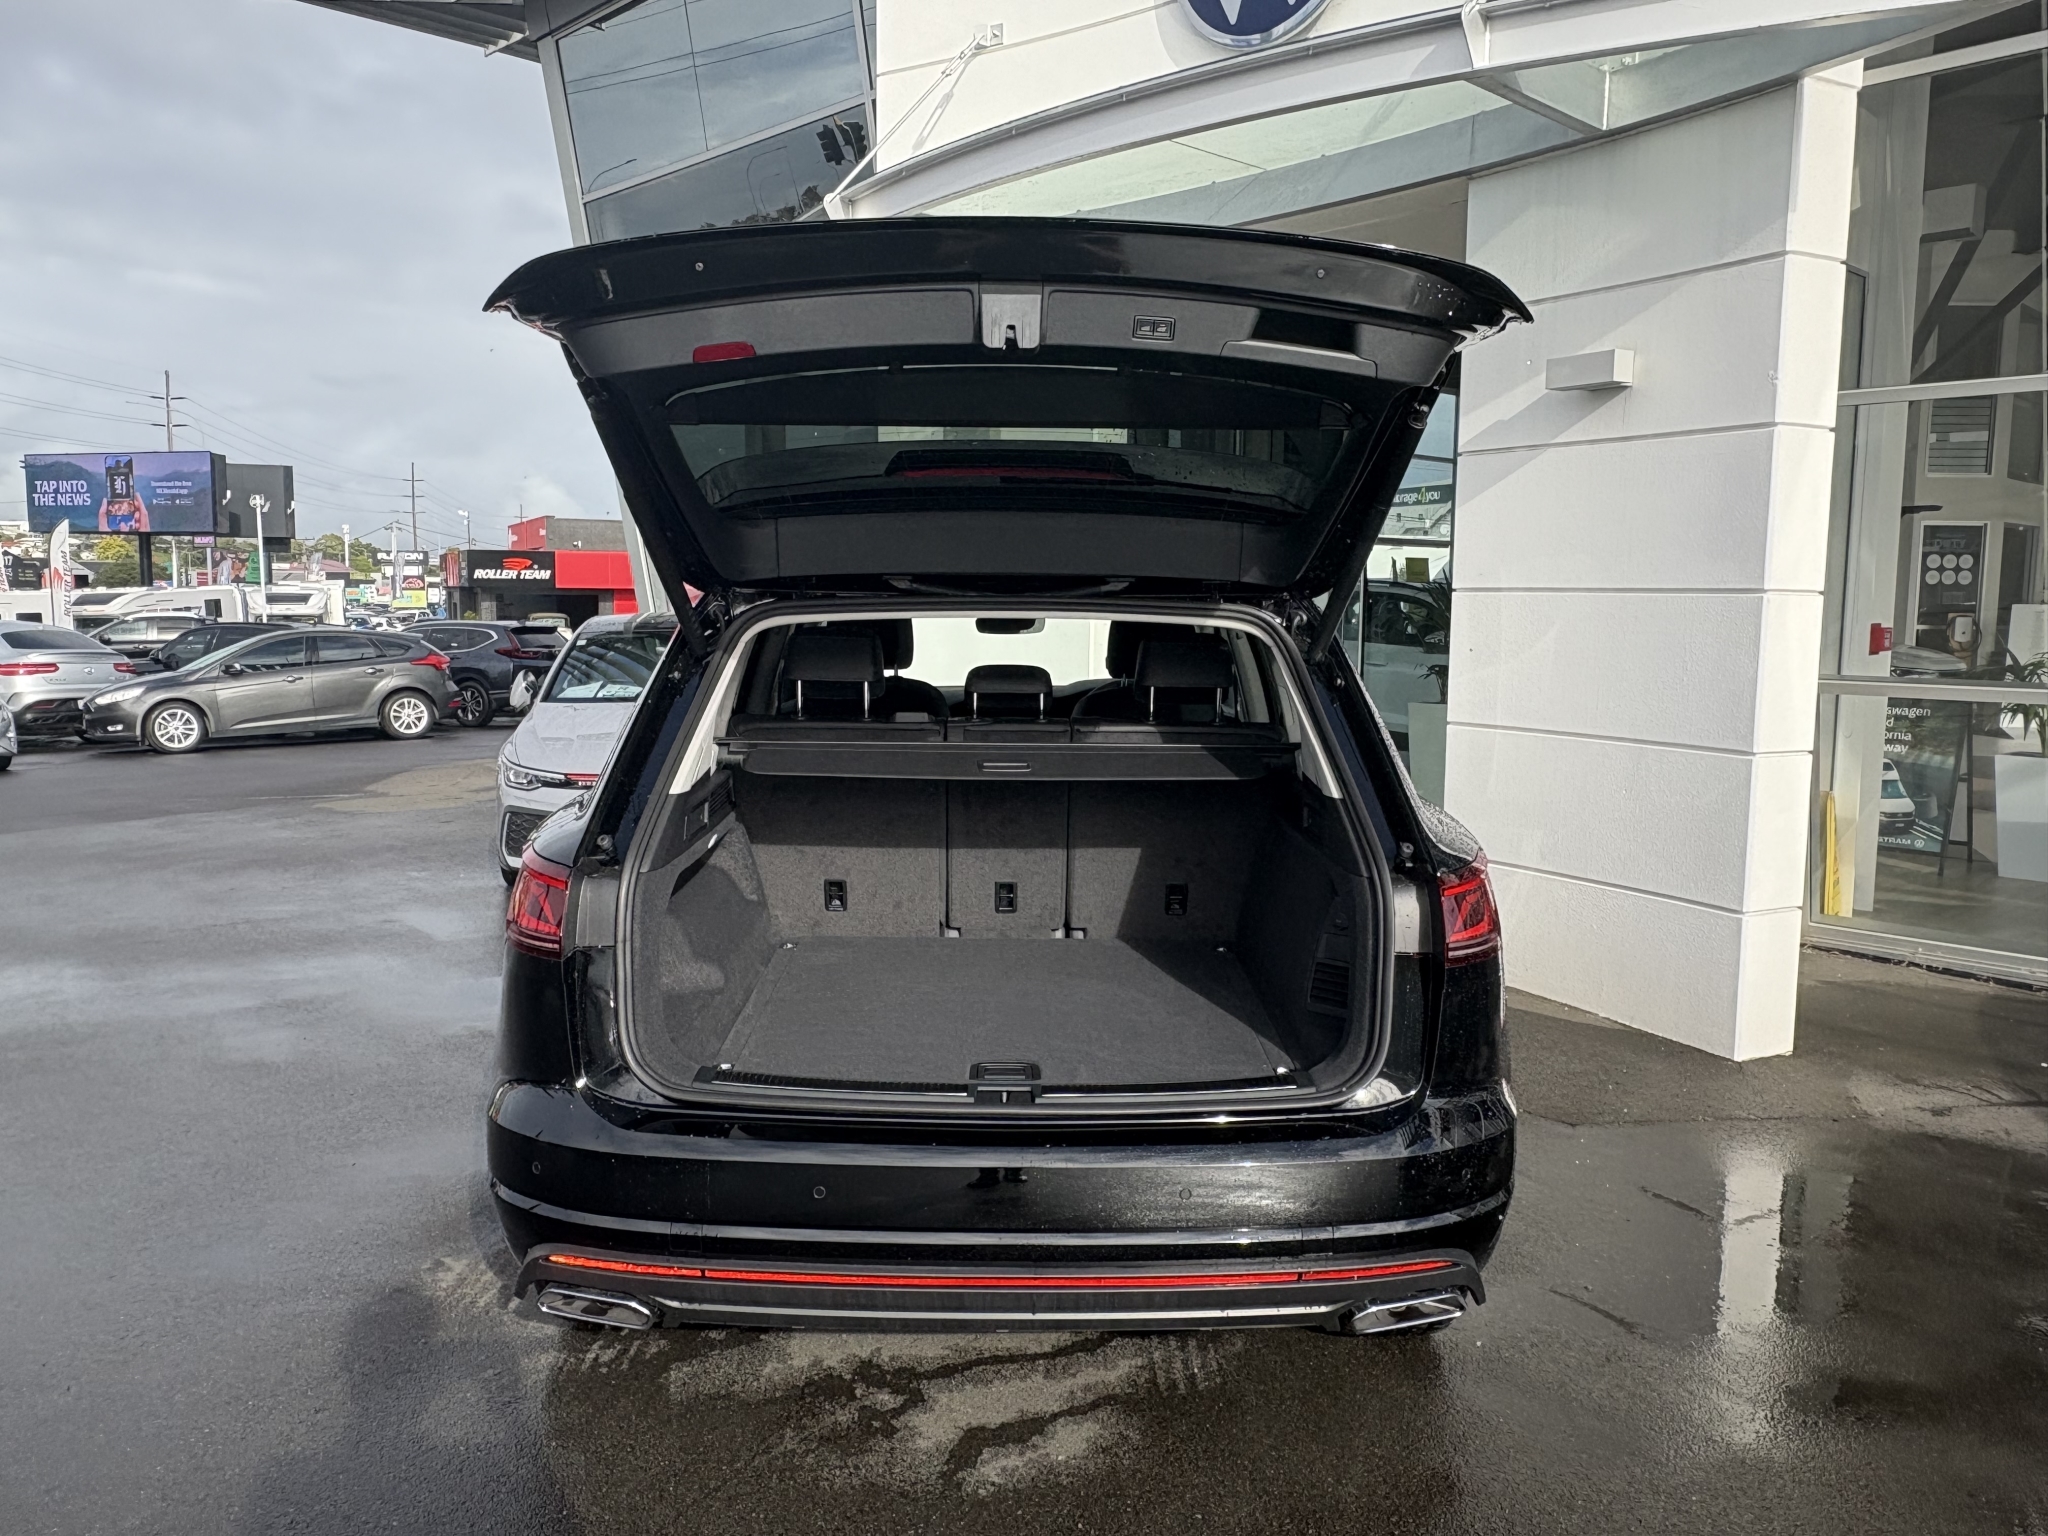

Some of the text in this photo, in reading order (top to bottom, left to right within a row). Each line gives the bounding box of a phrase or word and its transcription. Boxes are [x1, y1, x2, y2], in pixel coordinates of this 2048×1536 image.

[34, 480, 87, 493] TAP INTO
[32, 493, 91, 506] THE NEWS
[473, 568, 552, 580] ROLLER TEAM
[60, 550, 72, 617] ROLLER TEAM
